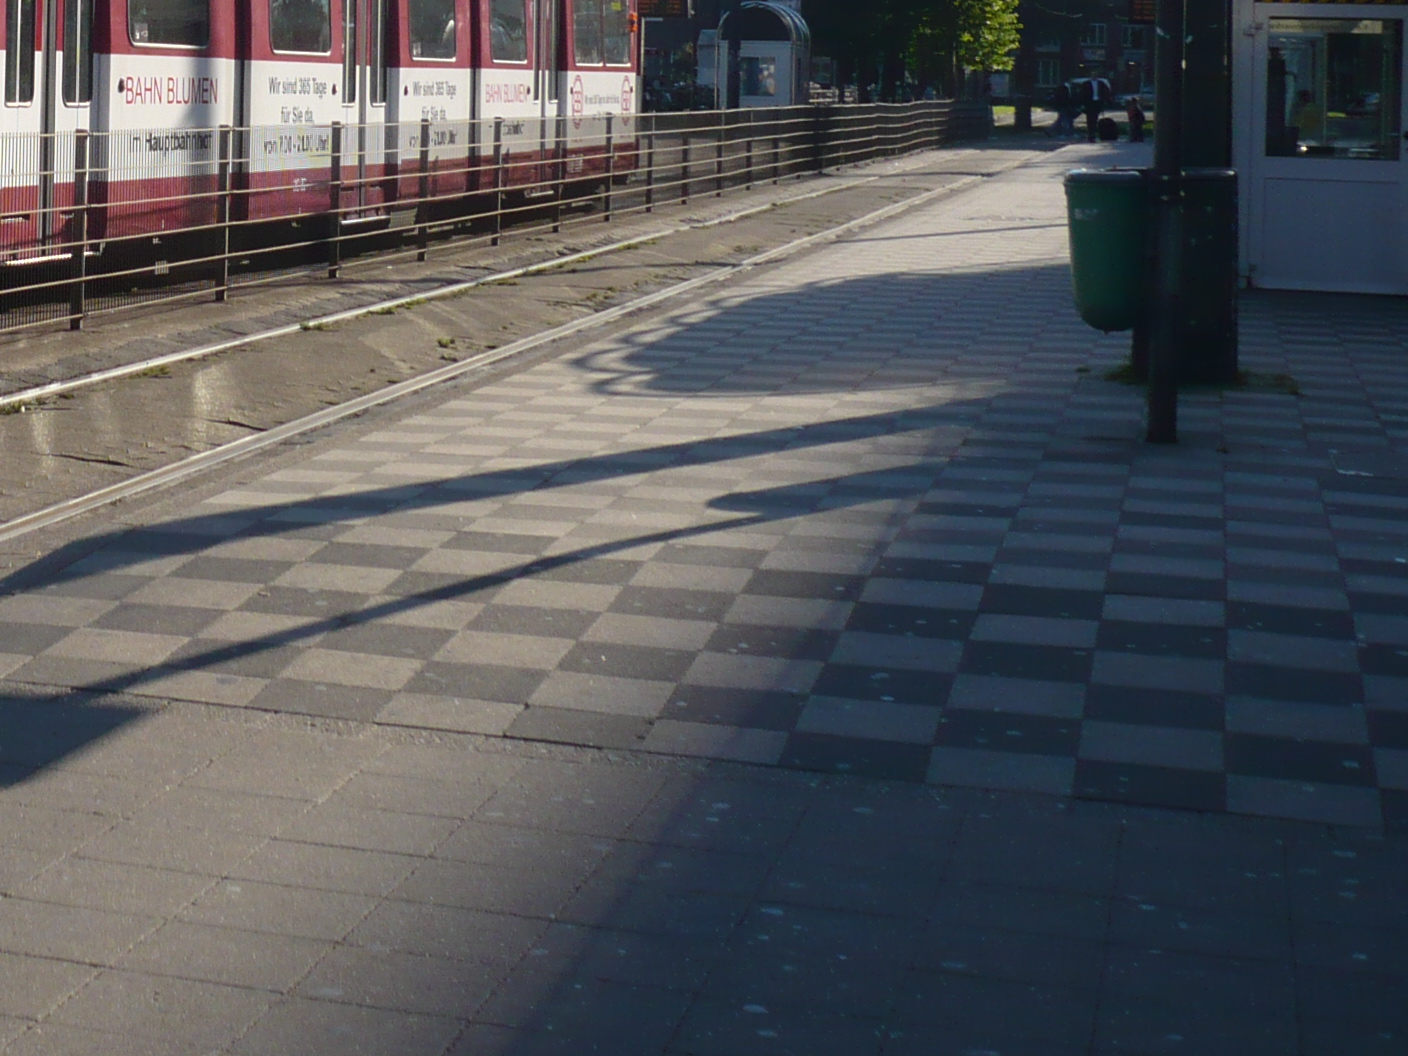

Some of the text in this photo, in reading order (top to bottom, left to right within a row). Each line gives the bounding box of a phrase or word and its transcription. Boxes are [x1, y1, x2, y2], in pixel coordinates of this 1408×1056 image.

[125, 77, 218, 105] BAHN BLUMEN
[268, 77, 327, 99] Wir sind 365 Tage
[485, 83, 503, 103] BAHN
